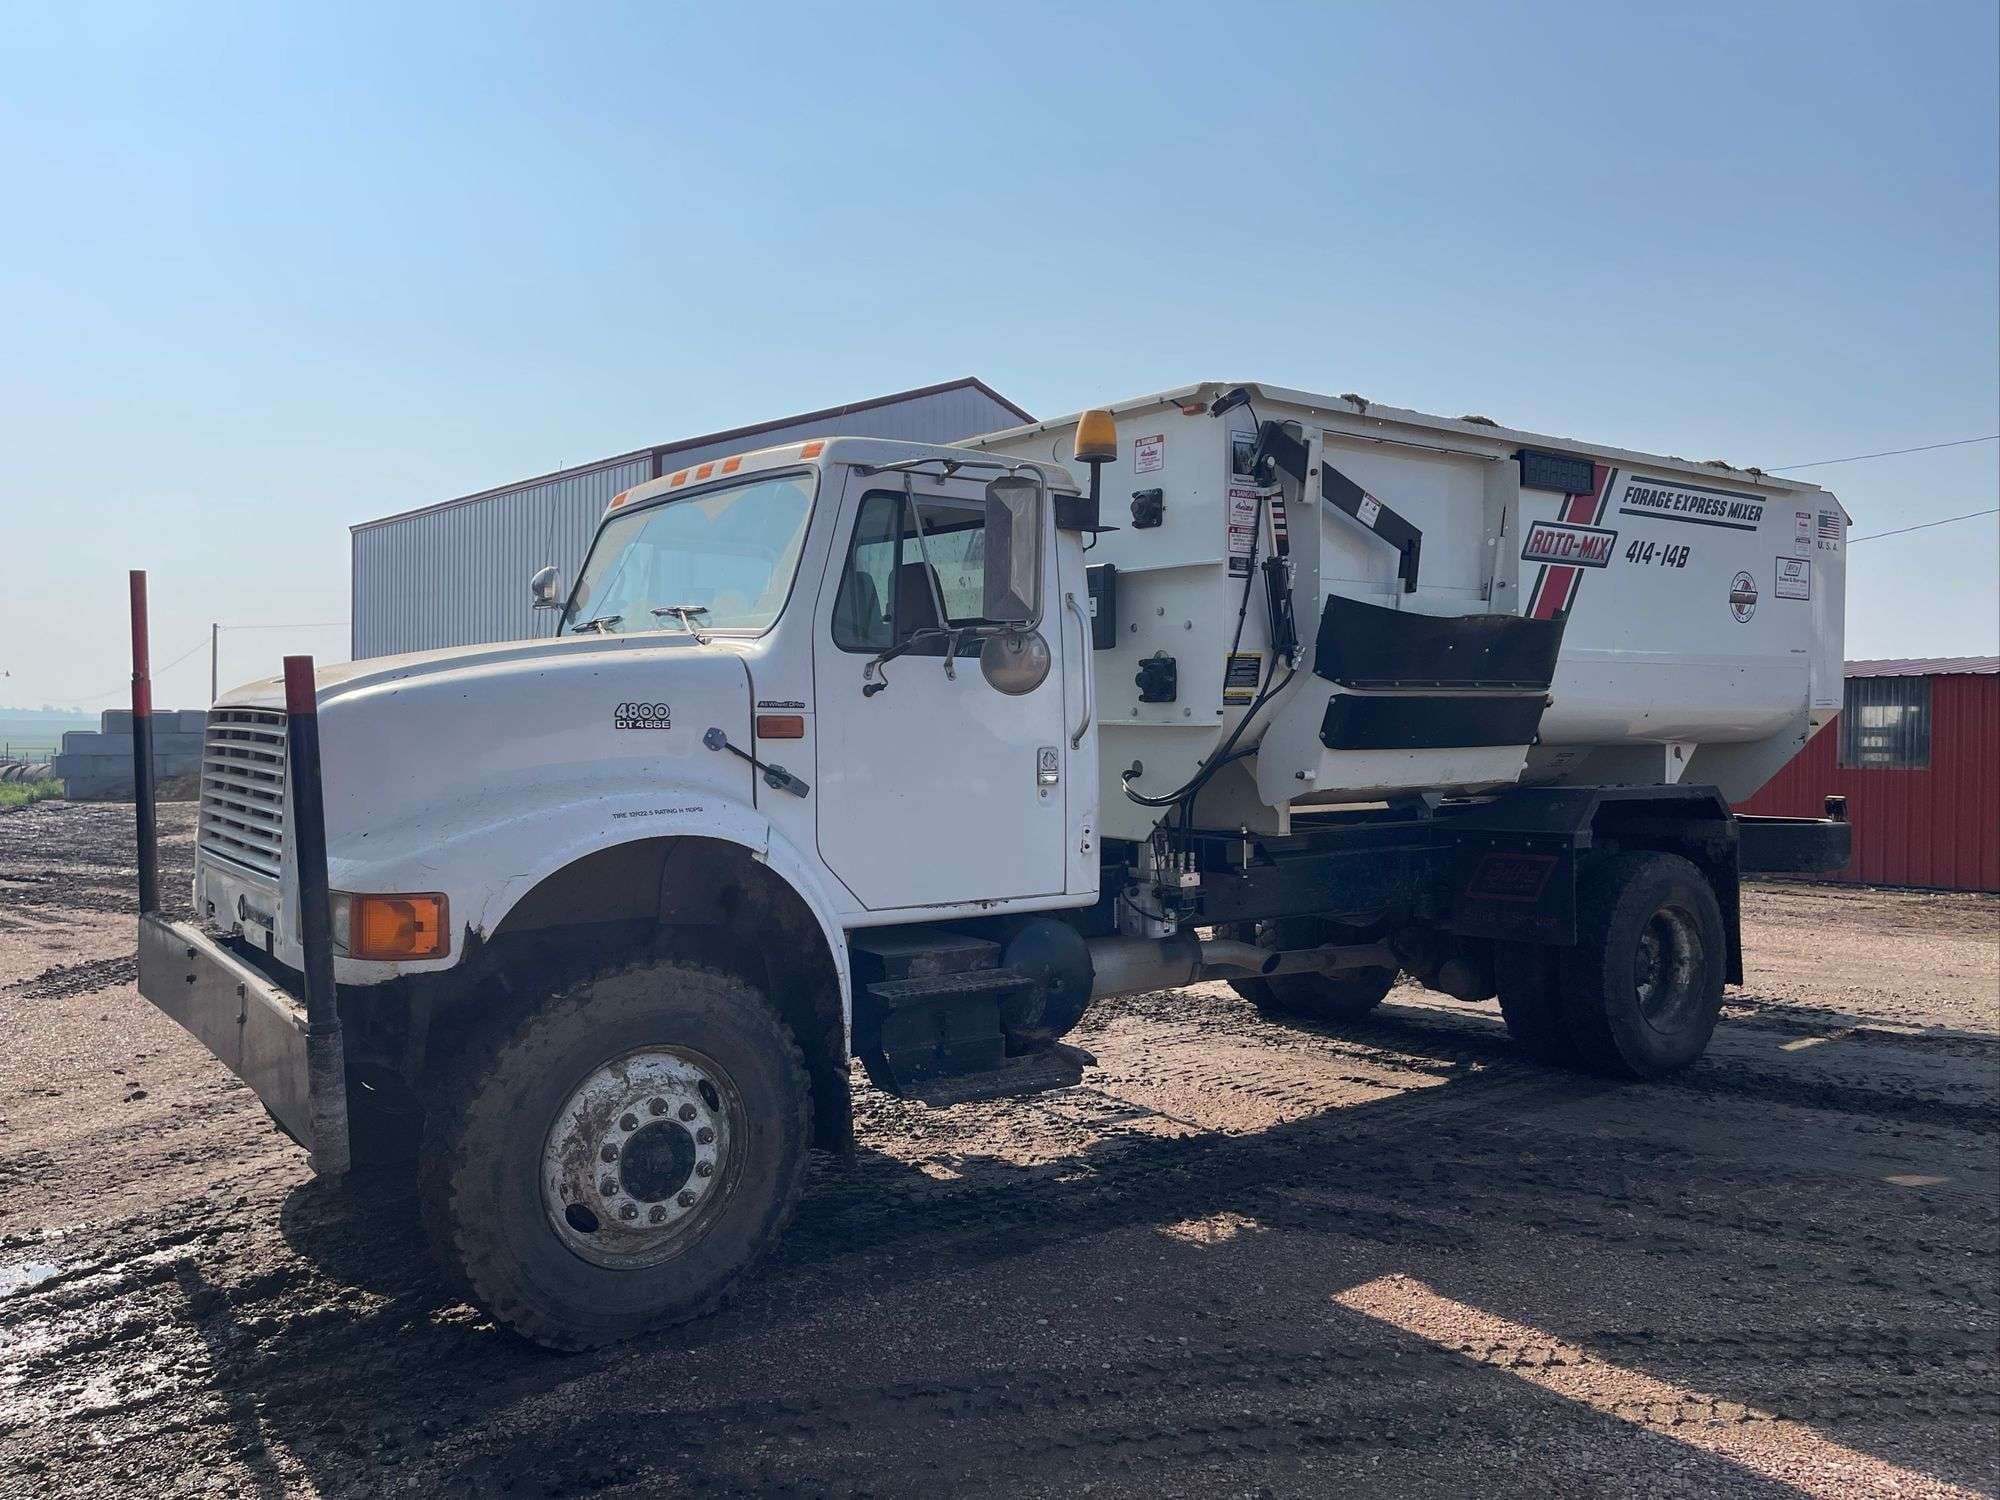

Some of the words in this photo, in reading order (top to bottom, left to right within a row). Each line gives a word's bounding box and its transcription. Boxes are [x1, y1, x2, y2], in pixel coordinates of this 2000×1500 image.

[1623, 486, 1671, 510] FORAGE
[1673, 494, 1726, 516] EXPRESS
[1727, 502, 1763, 522] MIXER
[1529, 529, 1611, 561] ROTO-MIX
[1625, 540, 1691, 569] 414-14B
[614, 703, 670, 720] 4800
[616, 720, 670, 729] DT466E
